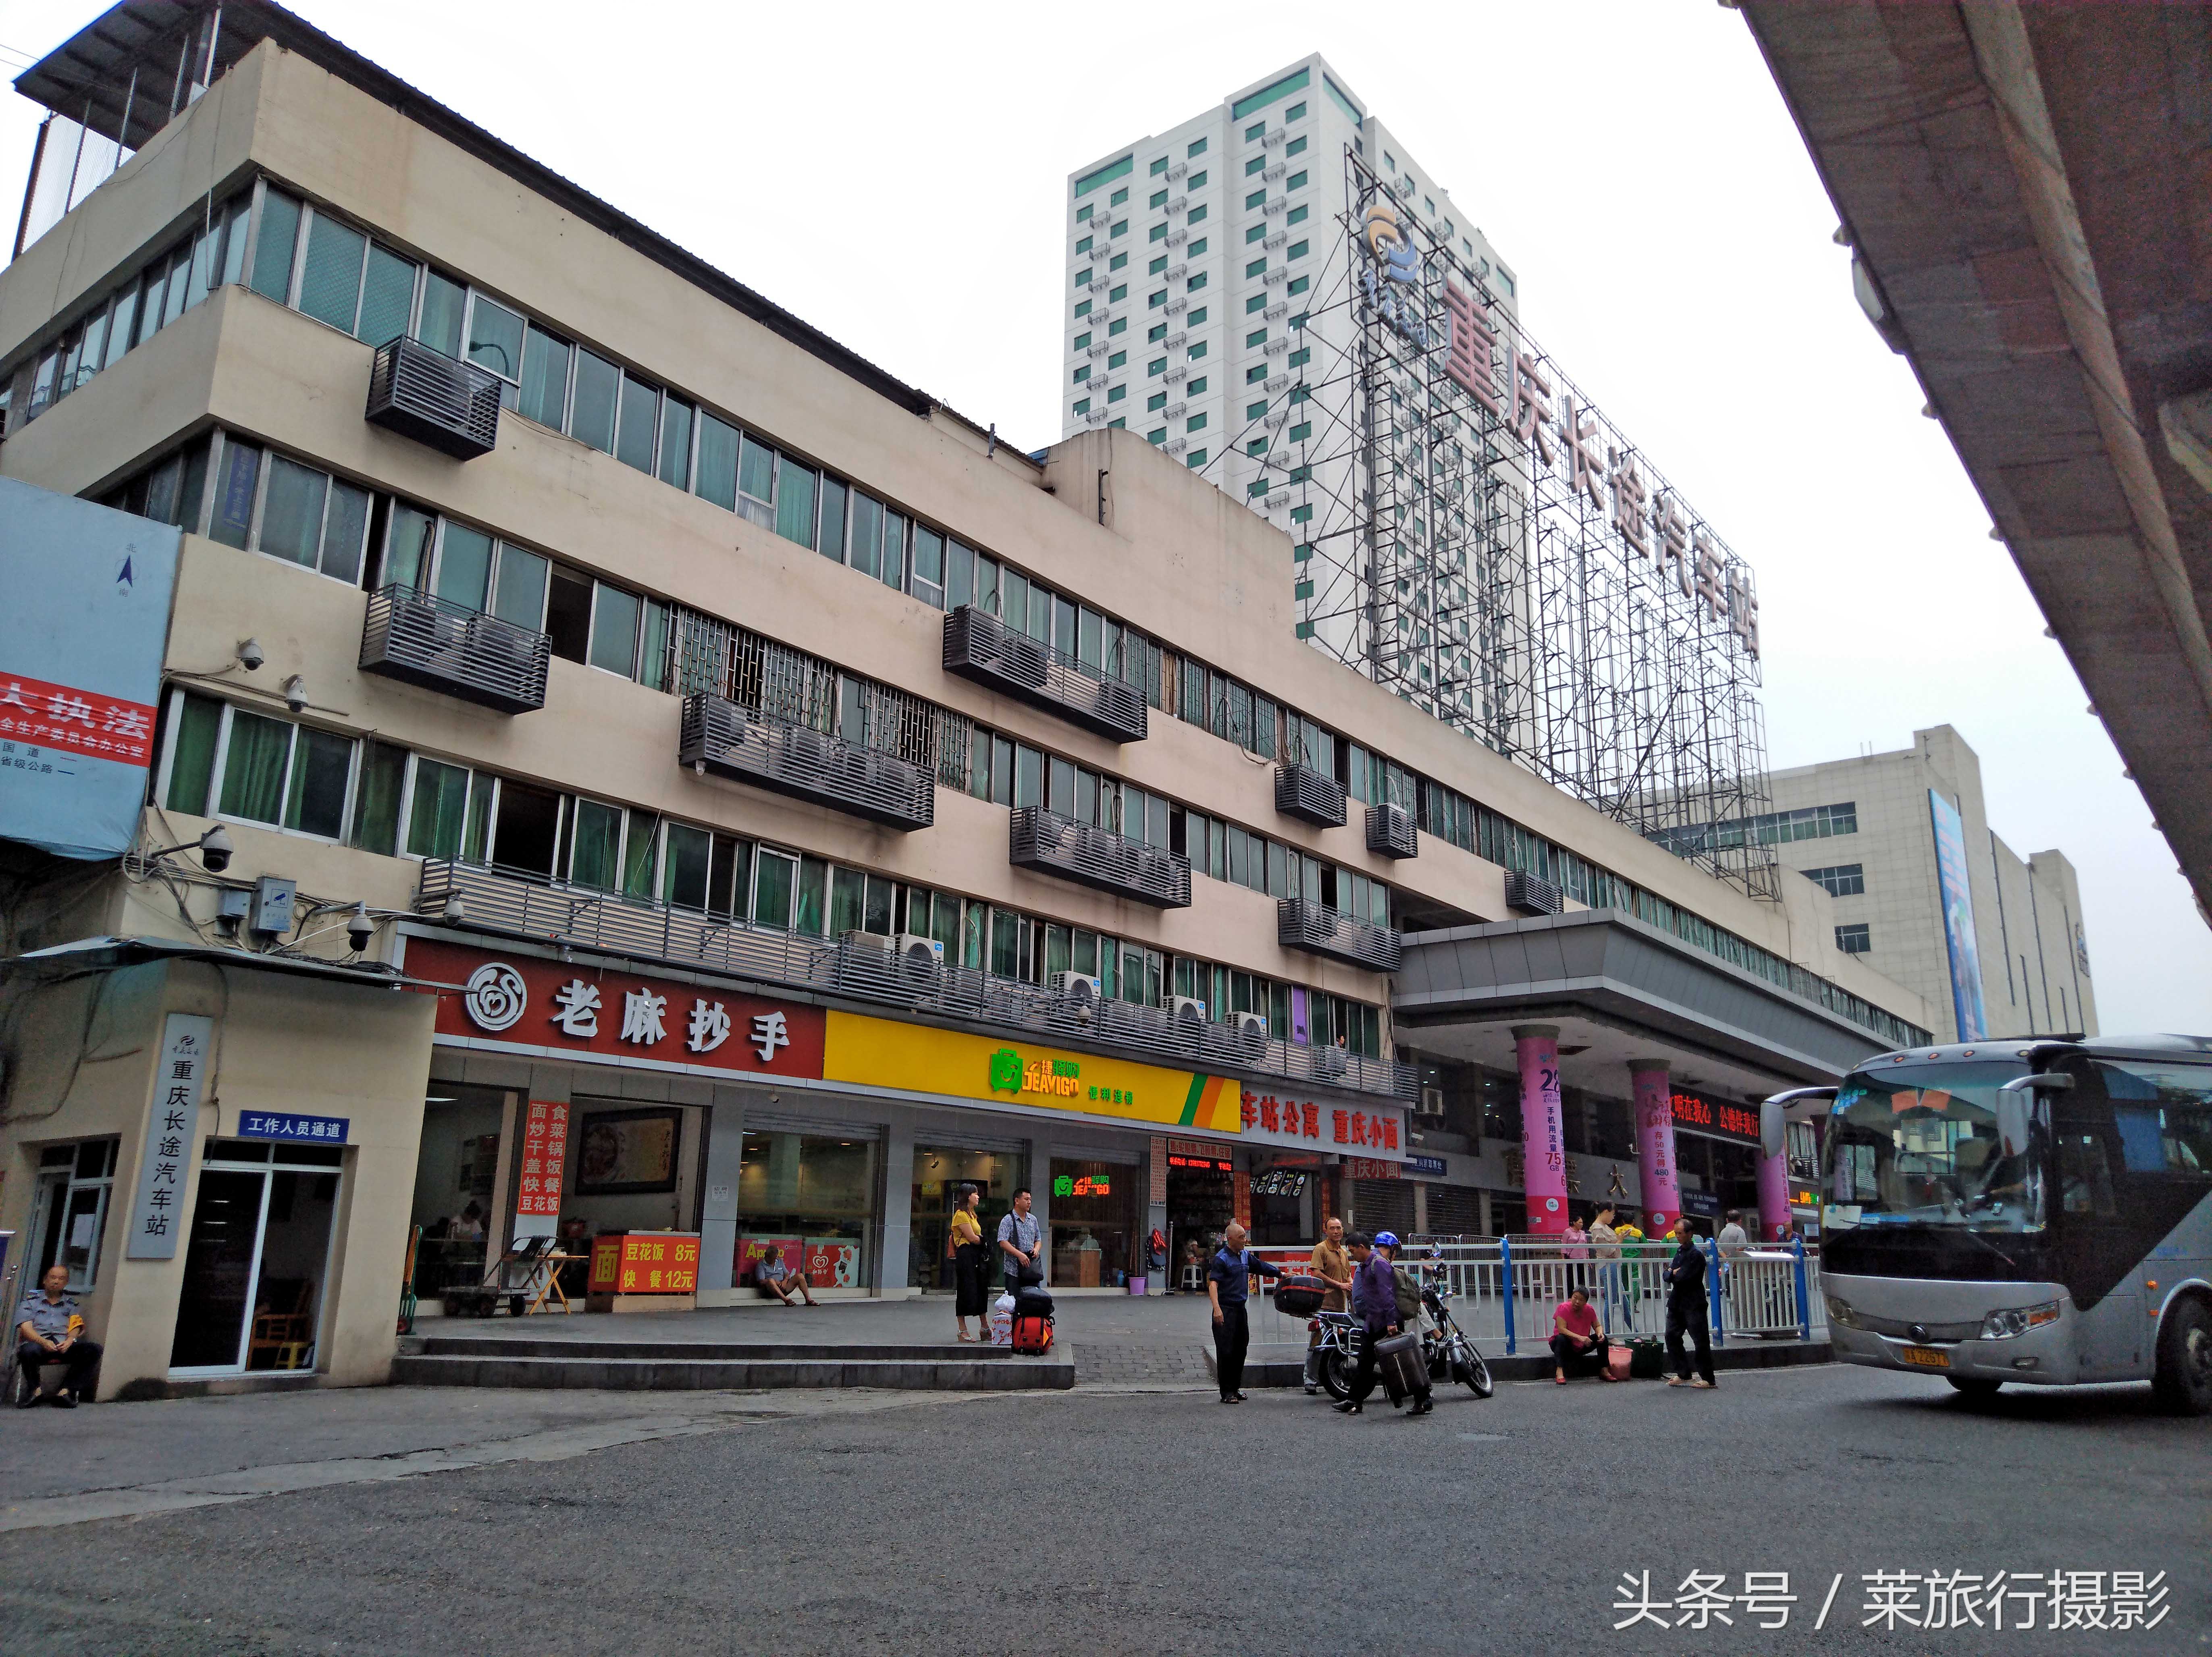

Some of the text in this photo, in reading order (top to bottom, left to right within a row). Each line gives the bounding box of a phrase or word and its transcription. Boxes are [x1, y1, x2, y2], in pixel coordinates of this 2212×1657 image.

[1437, 275, 1759, 658] 重庆长途汽车站
[126, 543, 136, 553] 北
[119, 588, 128, 597] 南
[0, 682, 150, 740] 大执法
[0, 717, 144, 758] 全生产委员会办公室
[3, 742, 40, 758] 国道
[1, 756, 53, 774] 省级公路
[552, 979, 790, 1061] 老麻抄手
[1042, 1059, 1080, 1079] 捷驿购
[1022, 1071, 1079, 1096] JEAYIGO
[1089, 1086, 1133, 1105] 便利连锁
[531, 1104, 567, 1120] 面食
[1241, 1091, 1398, 1150] 车站公寓 重庆小面
[247, 1117, 341, 1139] 工作人员通道
[529, 1123, 565, 1139] 炒菜
[1547, 1107, 1557, 1152] 手机用流量
[145, 1060, 193, 1236] 重庆长途汽车站
[527, 1140, 563, 1157] 干锅
[526, 1158, 561, 1175] 盖饭
[1545, 1153, 1561, 1165] 75
[1345, 1159, 1398, 1179] 重庆小面
[524, 1177, 560, 1193] 快餐
[521, 1195, 558, 1212] 豆花饭
[626, 1242, 696, 1262] 豆花饭 8元
[596, 1244, 620, 1283] 面
[624, 1269, 693, 1288] 快餐 12元
